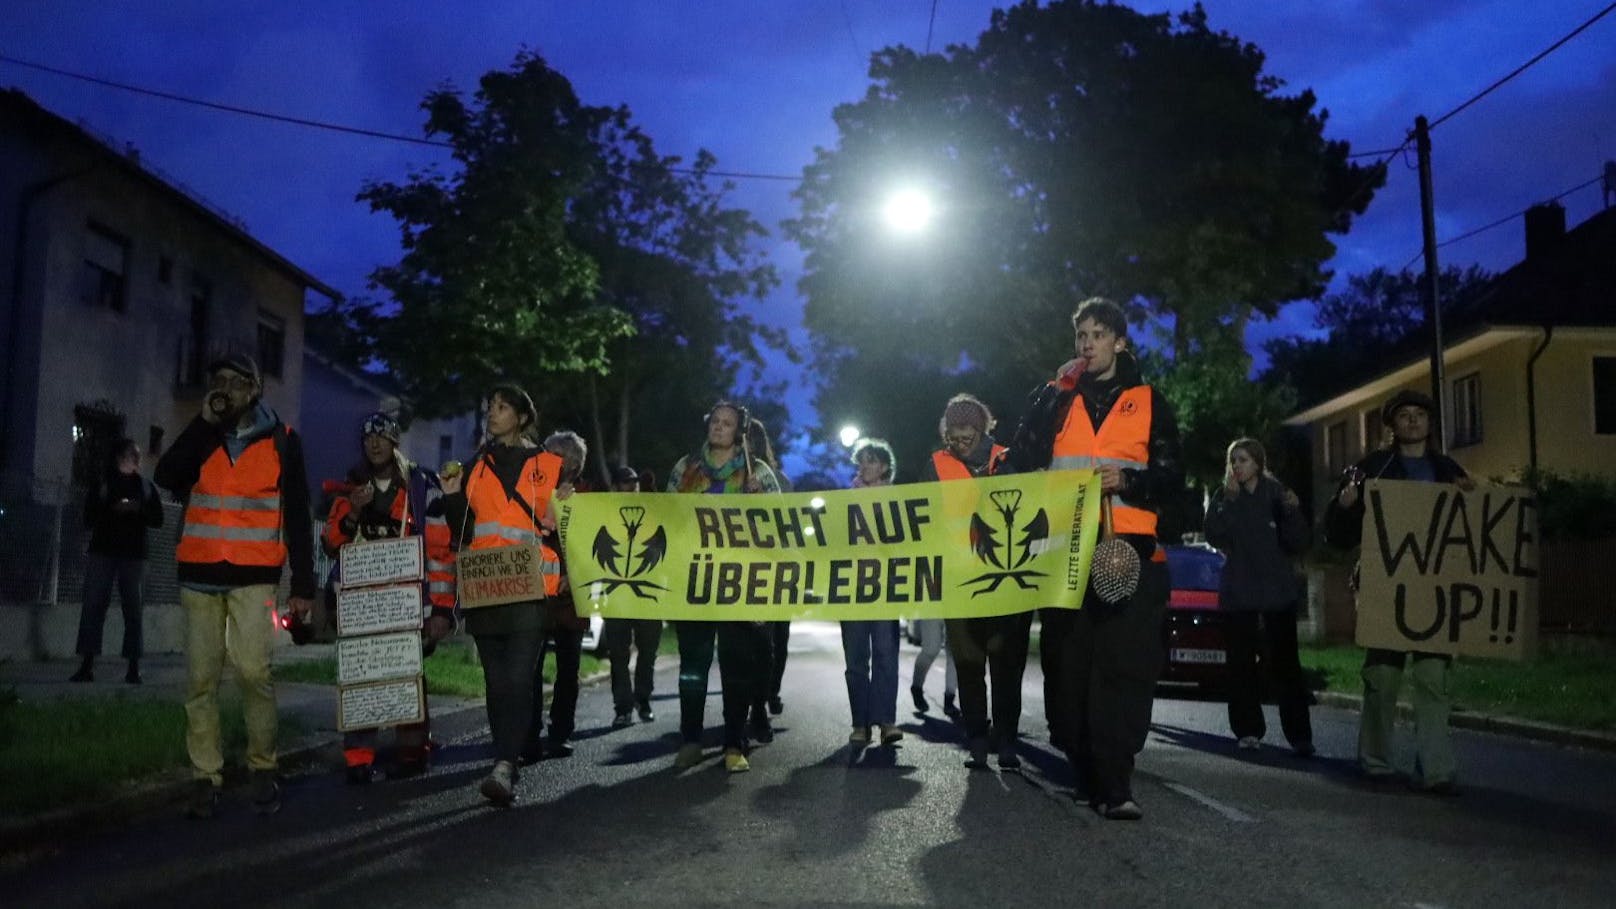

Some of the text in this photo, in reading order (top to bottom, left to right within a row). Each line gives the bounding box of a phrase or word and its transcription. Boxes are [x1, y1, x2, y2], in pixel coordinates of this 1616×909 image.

[695, 498, 930, 548] RECHT AUF
[1068, 483, 1086, 591] LETZTE GENERATION.AT
[1370, 490, 1538, 577] WAKE
[460, 548, 531, 569] IGNORIERE UNS
[462, 564, 495, 580] EINFACH
[515, 560, 530, 576] DIE
[686, 554, 943, 605] ÜBERLEBEN
[463, 576, 534, 601] KLIMAKRISE
[1395, 583, 1517, 644] UP!!
